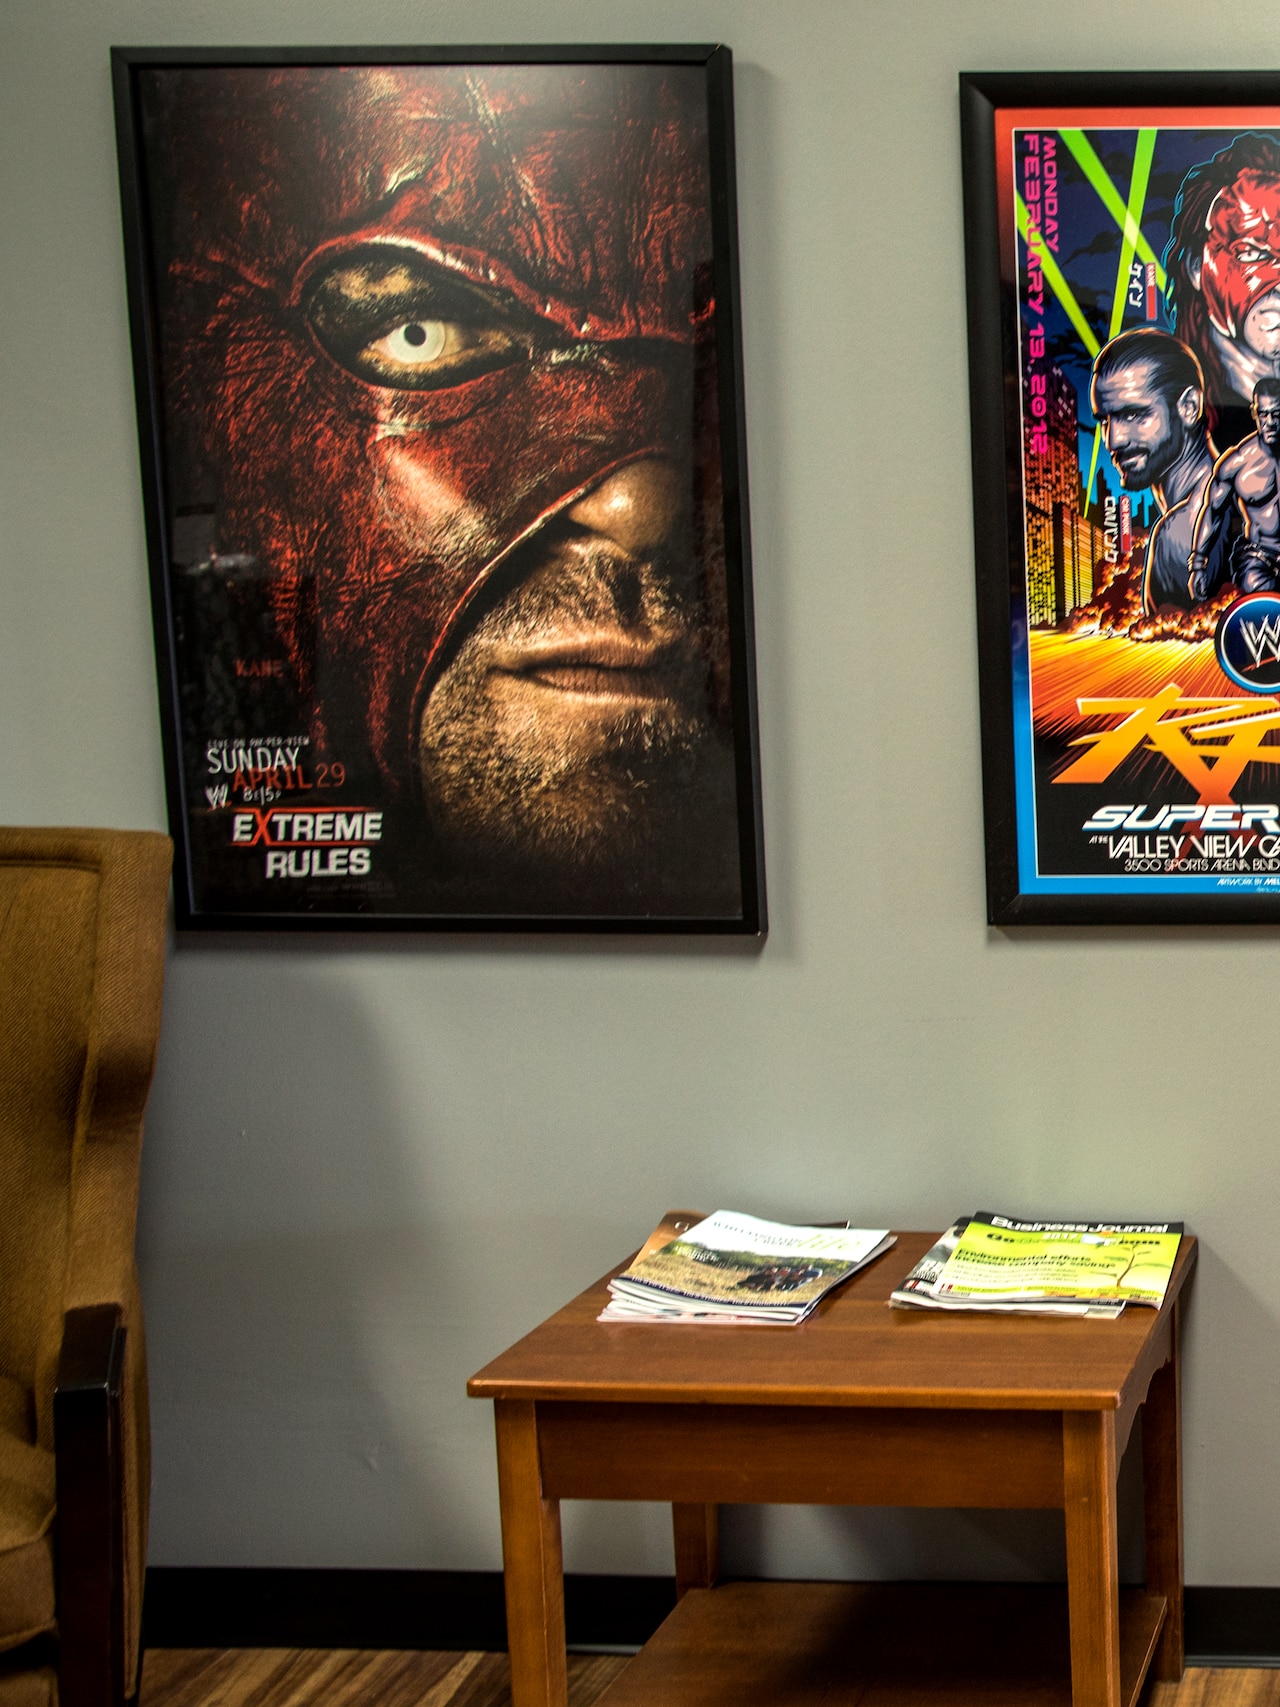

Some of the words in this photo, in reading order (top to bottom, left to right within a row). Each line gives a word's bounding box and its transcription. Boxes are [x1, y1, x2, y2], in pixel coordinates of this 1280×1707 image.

[1042, 136, 1060, 253] MONDAY
[1023, 133, 1045, 315] FEBRUARY
[1030, 374, 1048, 454] 2012
[207, 747, 300, 774] SUNDAY
[232, 764, 313, 792] APRIL
[315, 762, 346, 788] 29
[232, 808, 383, 846] EXTREME
[1108, 835, 1185, 859] VALLEY
[1189, 835, 1258, 859] VIEW
[265, 848, 372, 878] RULES
[1124, 858, 1162, 872] 3500
[1164, 858, 1209, 872] SPORTS
[1210, 858, 1251, 871] ARENA
[990, 1215, 1089, 1232] Business
[1088, 1223, 1169, 1233] Journal
